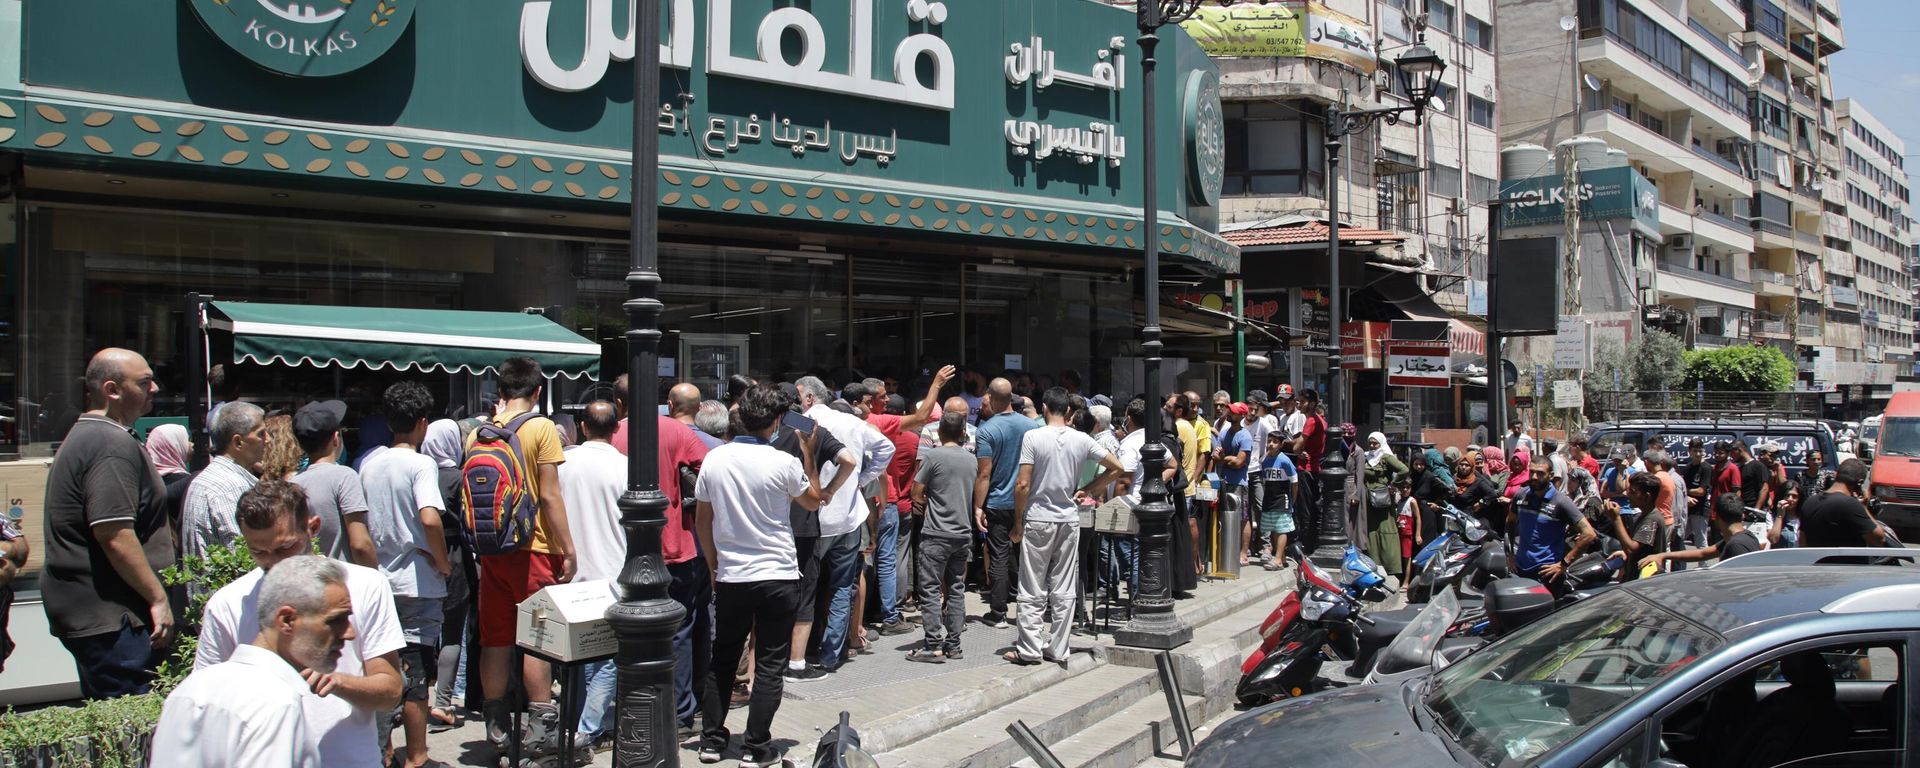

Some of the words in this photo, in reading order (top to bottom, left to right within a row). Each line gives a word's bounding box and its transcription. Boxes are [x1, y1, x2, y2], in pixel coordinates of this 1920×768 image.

[1217, 11, 1299, 22] مختار
[245, 20, 358, 56] KOLKAS
[1005, 36, 1125, 90] أفران
[658, 93, 694, 132] آخ
[703, 114, 761, 154] فرع
[771, 112, 830, 155] لدينا
[840, 129, 896, 164] ليس
[1005, 120, 1125, 166] باتيسري
[1394, 358, 1446, 374] مختار
